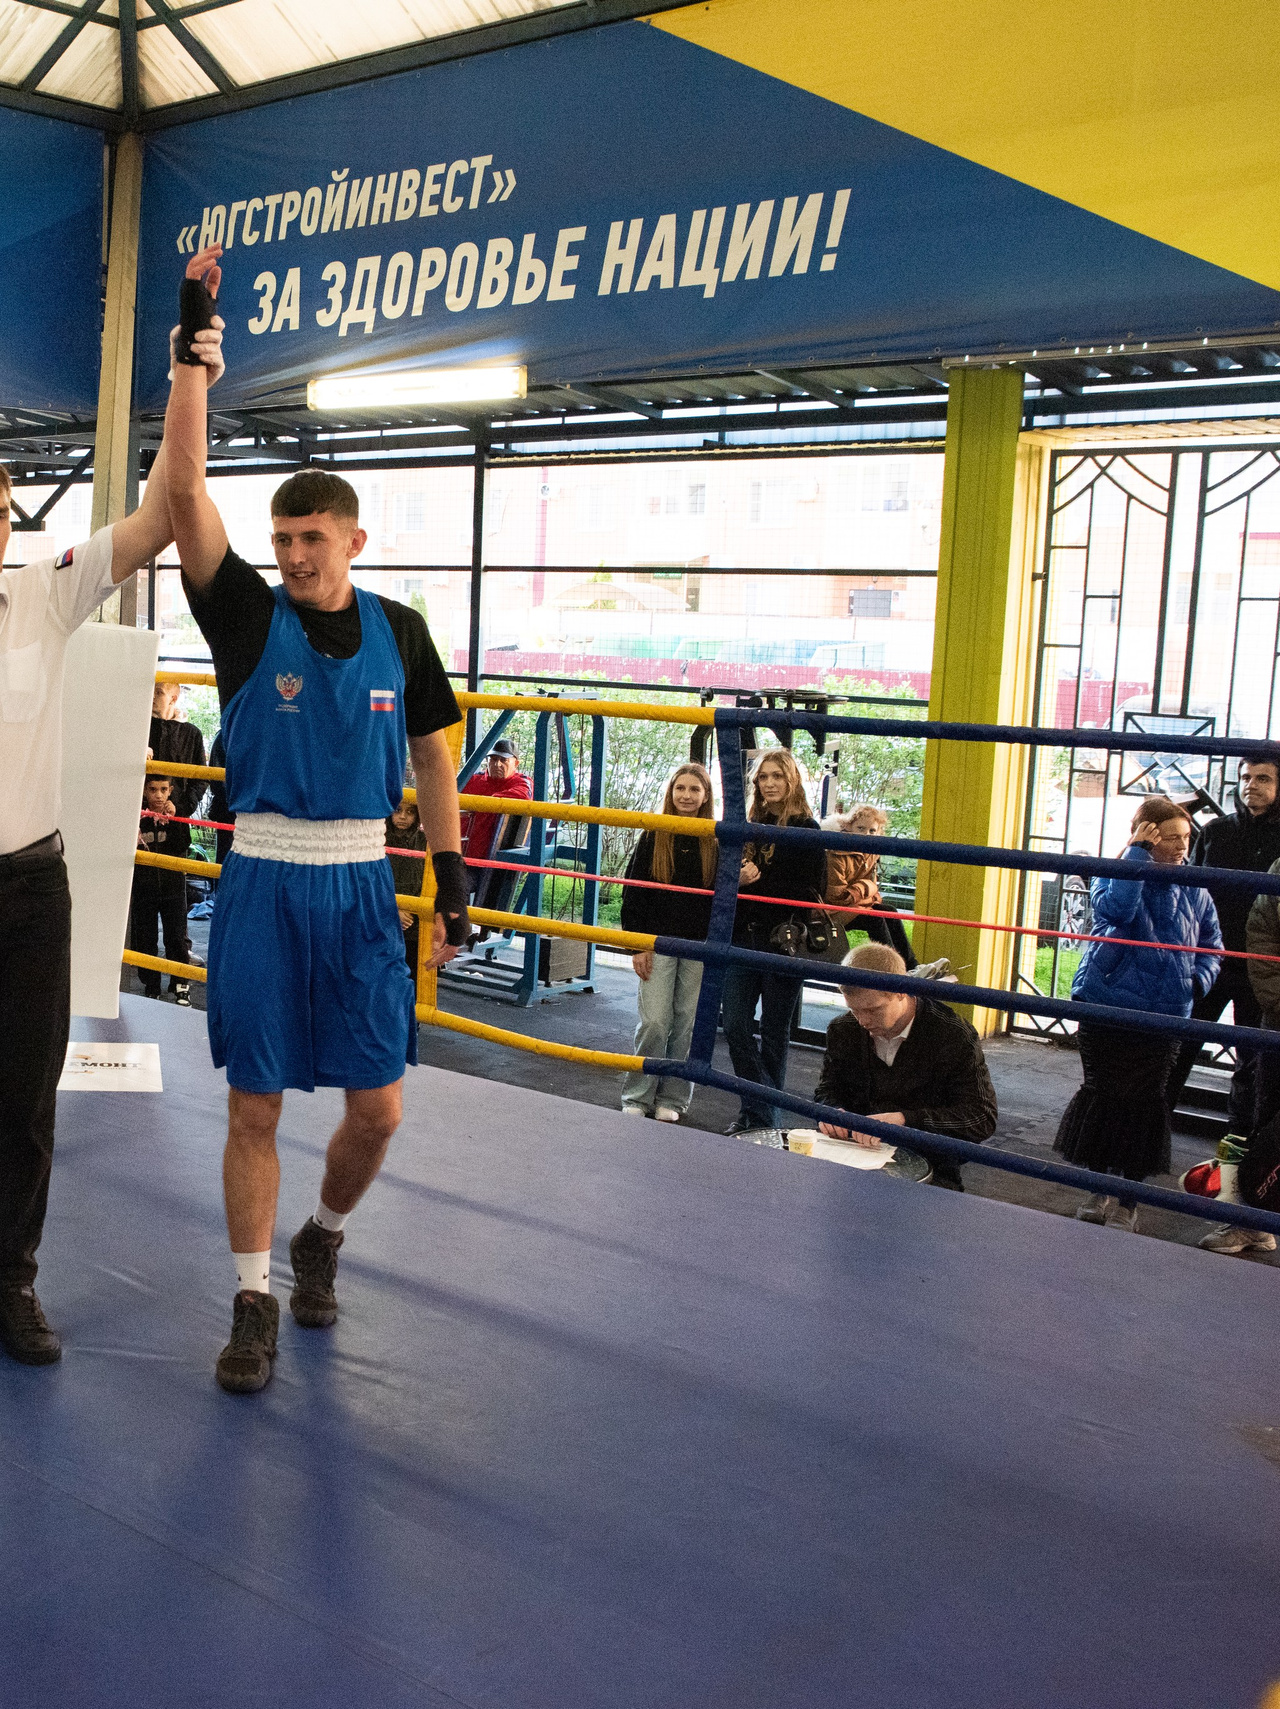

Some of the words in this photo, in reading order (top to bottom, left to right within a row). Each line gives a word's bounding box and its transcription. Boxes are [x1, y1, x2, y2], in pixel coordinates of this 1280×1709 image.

[176, 154, 517, 254] «ЮГСТРОЙИНВЕСТ»
[248, 267, 302, 335] ЗА
[315, 225, 588, 336] ЗДОРОВЬЕ
[597, 188, 852, 299] НАЦИИ!
